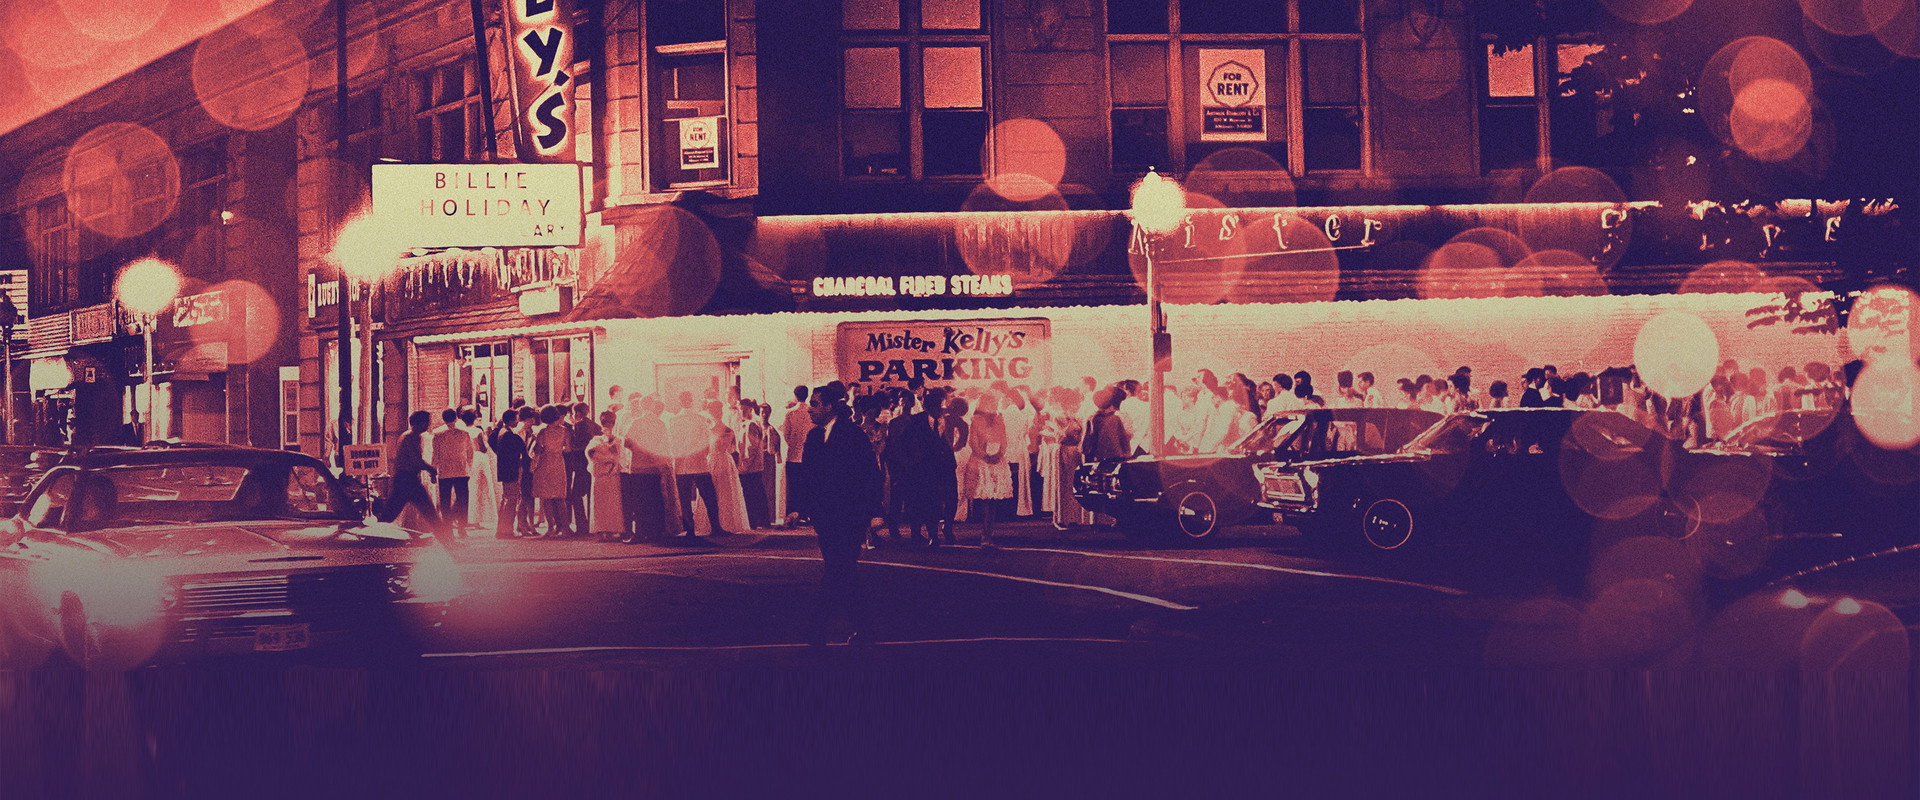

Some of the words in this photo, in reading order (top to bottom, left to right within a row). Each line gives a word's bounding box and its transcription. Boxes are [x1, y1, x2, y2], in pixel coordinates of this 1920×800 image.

[1223, 73, 1242, 81] FOR
[1217, 83, 1249, 96] RENT
[690, 133, 706, 141] RENT
[435, 172, 527, 189] BILLIE
[420, 199, 550, 216] HOLIDAY
[812, 276, 896, 297] CHARCOAL
[899, 275, 946, 297] FIRED
[950, 274, 1013, 296] STEAKS
[866, 330, 935, 352] Mister
[943, 327, 1026, 356] Kelly's
[857, 357, 1033, 383] PARKING
